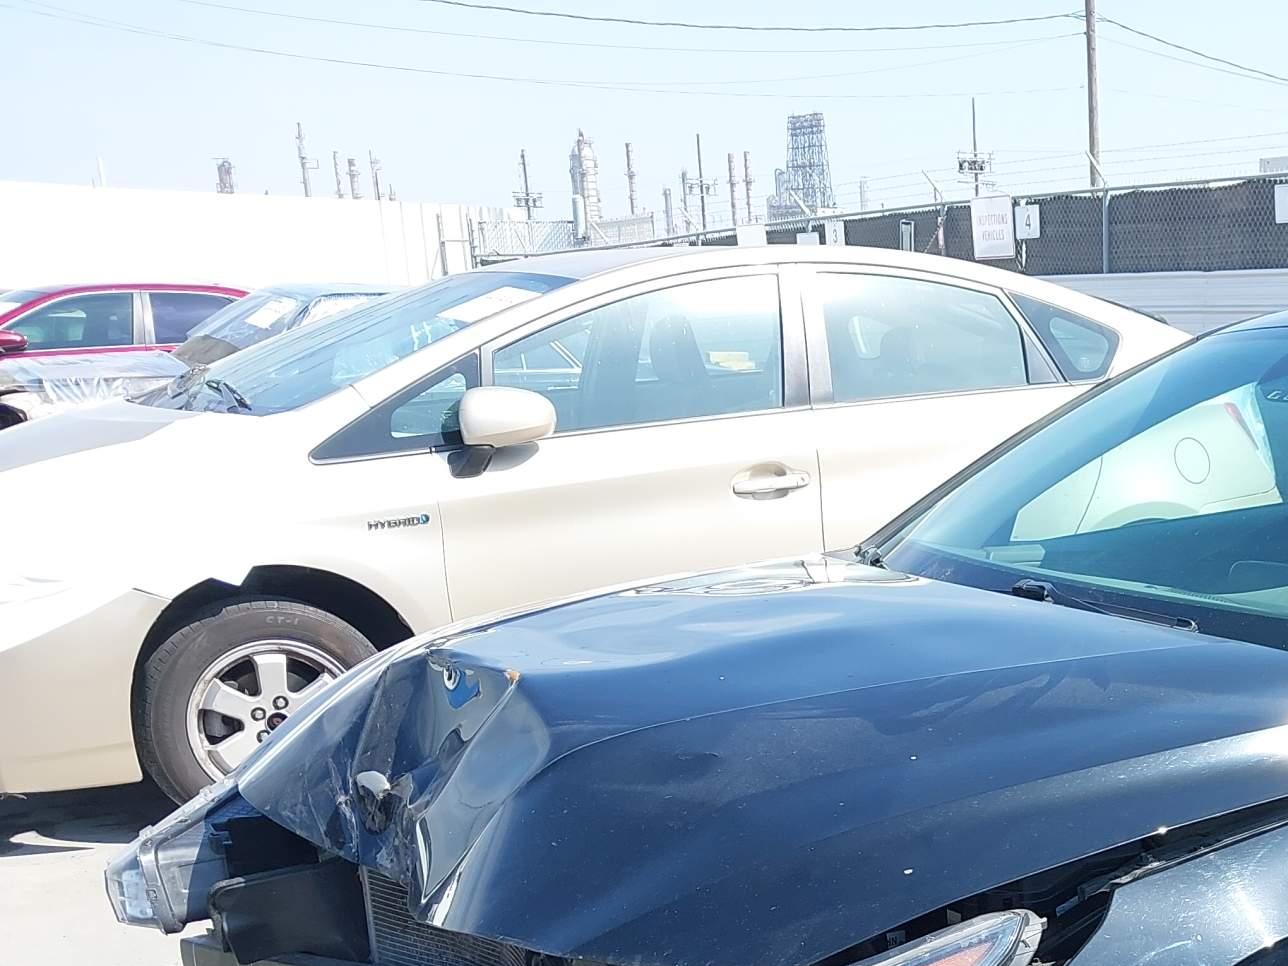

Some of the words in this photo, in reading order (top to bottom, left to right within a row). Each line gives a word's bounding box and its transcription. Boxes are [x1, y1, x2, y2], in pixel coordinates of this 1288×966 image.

[1024, 214, 1031, 230] 4
[832, 228, 838, 243] 3
[367, 516, 420, 531] HYBRID
